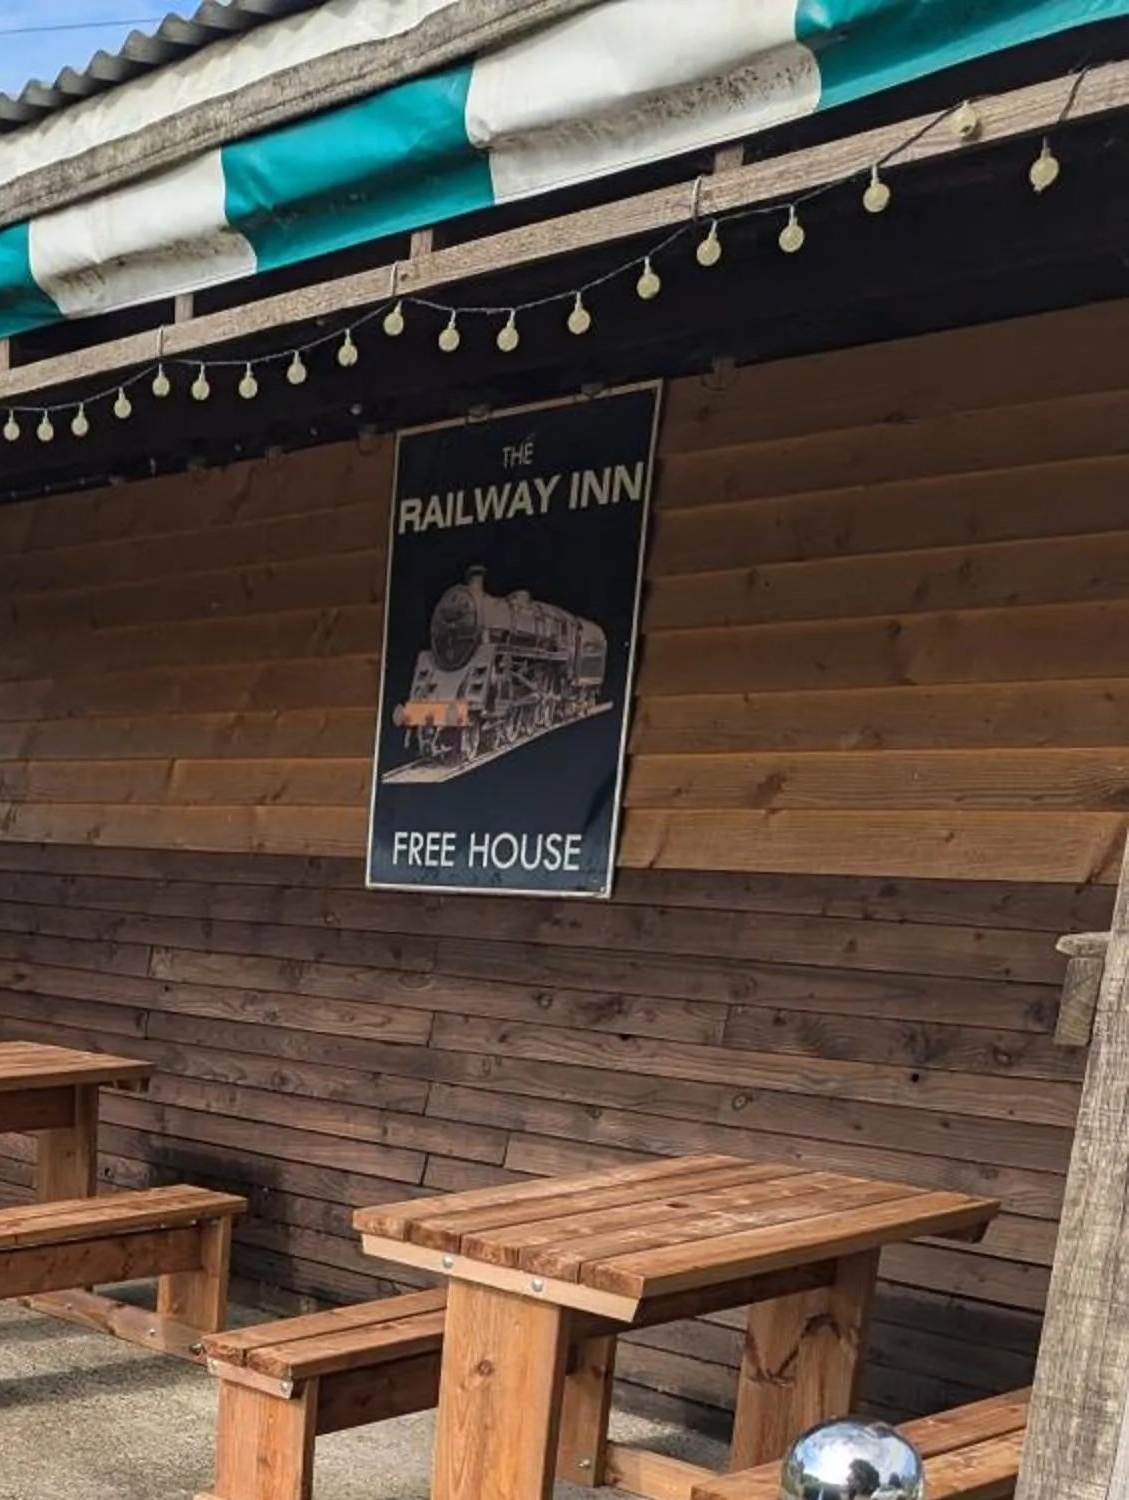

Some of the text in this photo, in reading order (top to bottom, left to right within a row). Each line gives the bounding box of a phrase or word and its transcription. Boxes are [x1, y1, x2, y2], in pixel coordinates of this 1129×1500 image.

[502, 442, 534, 469] THE
[397, 461, 645, 535] RAILWAY INN
[391, 831, 583, 872] FREE HOUSE
